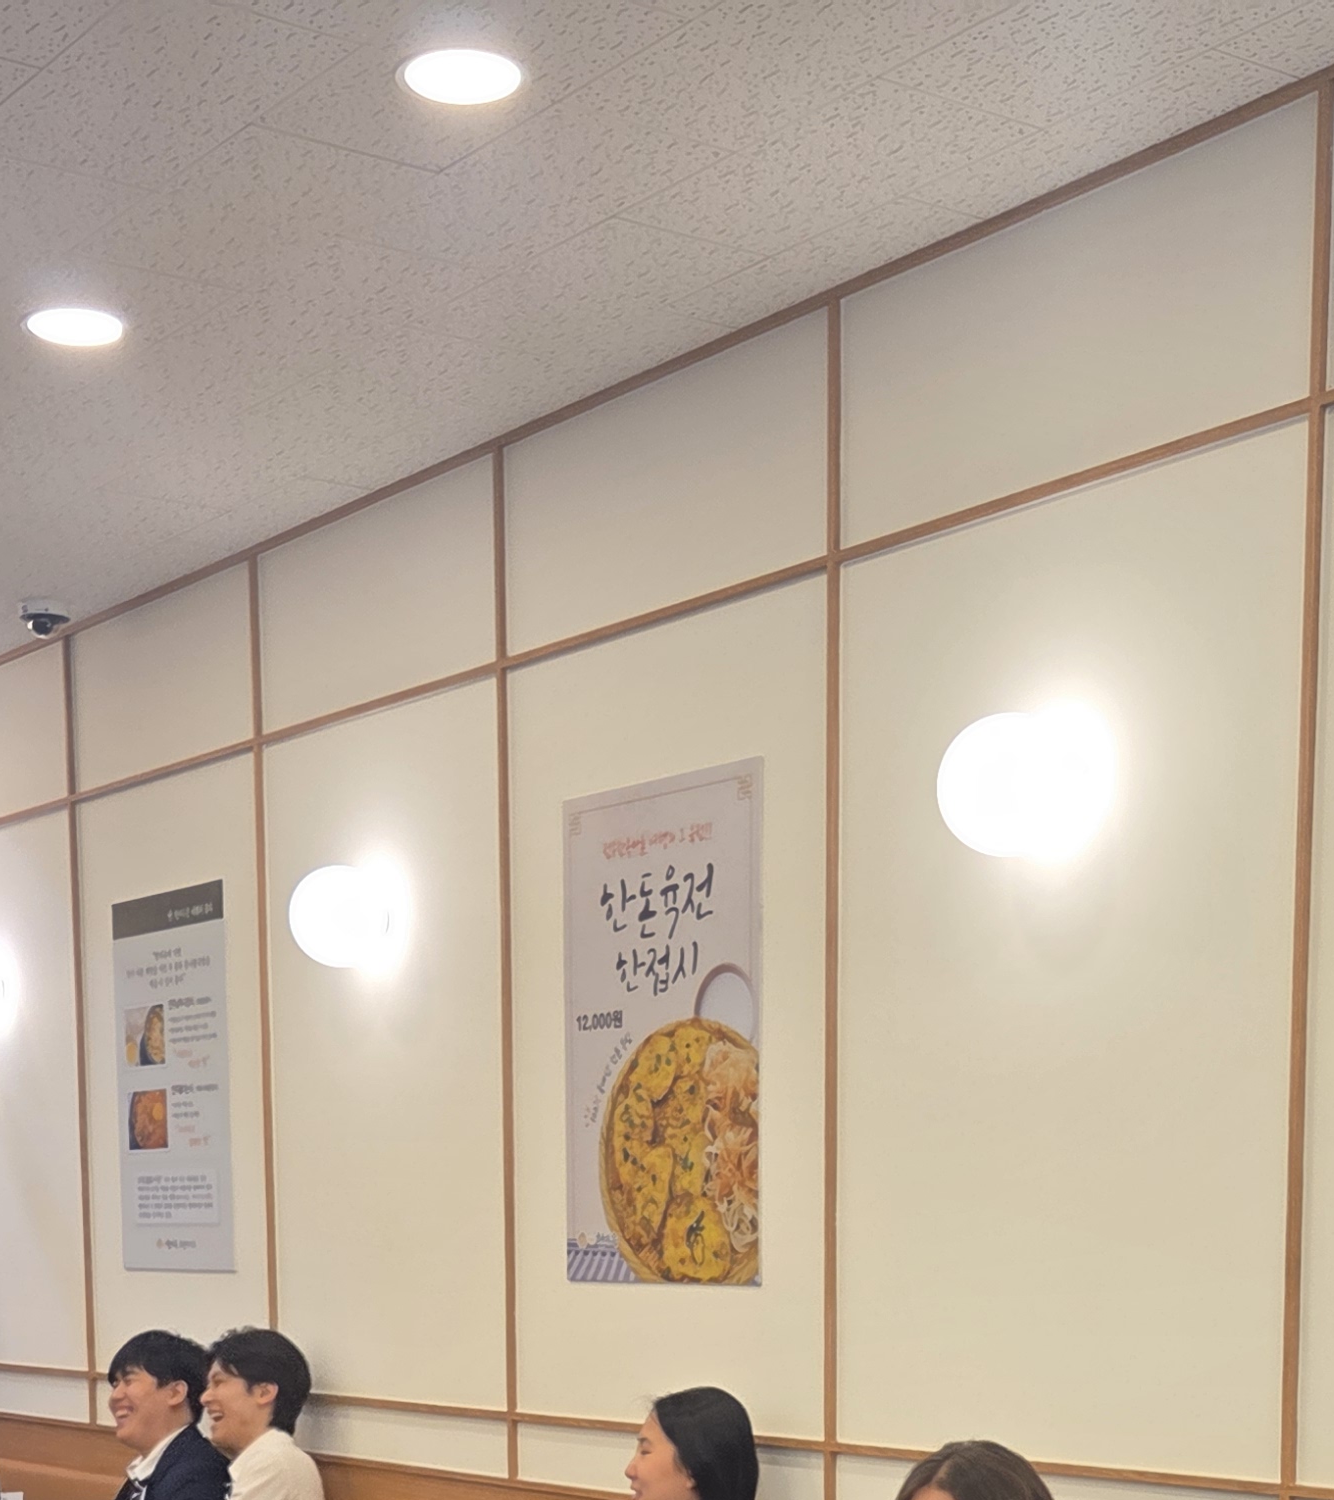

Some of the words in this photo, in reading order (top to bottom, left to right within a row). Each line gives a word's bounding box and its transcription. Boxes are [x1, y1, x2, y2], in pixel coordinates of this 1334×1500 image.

[600, 862, 714, 939] 한돈육전
[616, 941, 699, 996] 한접시
[576, 1009, 623, 1031] 12,000원
